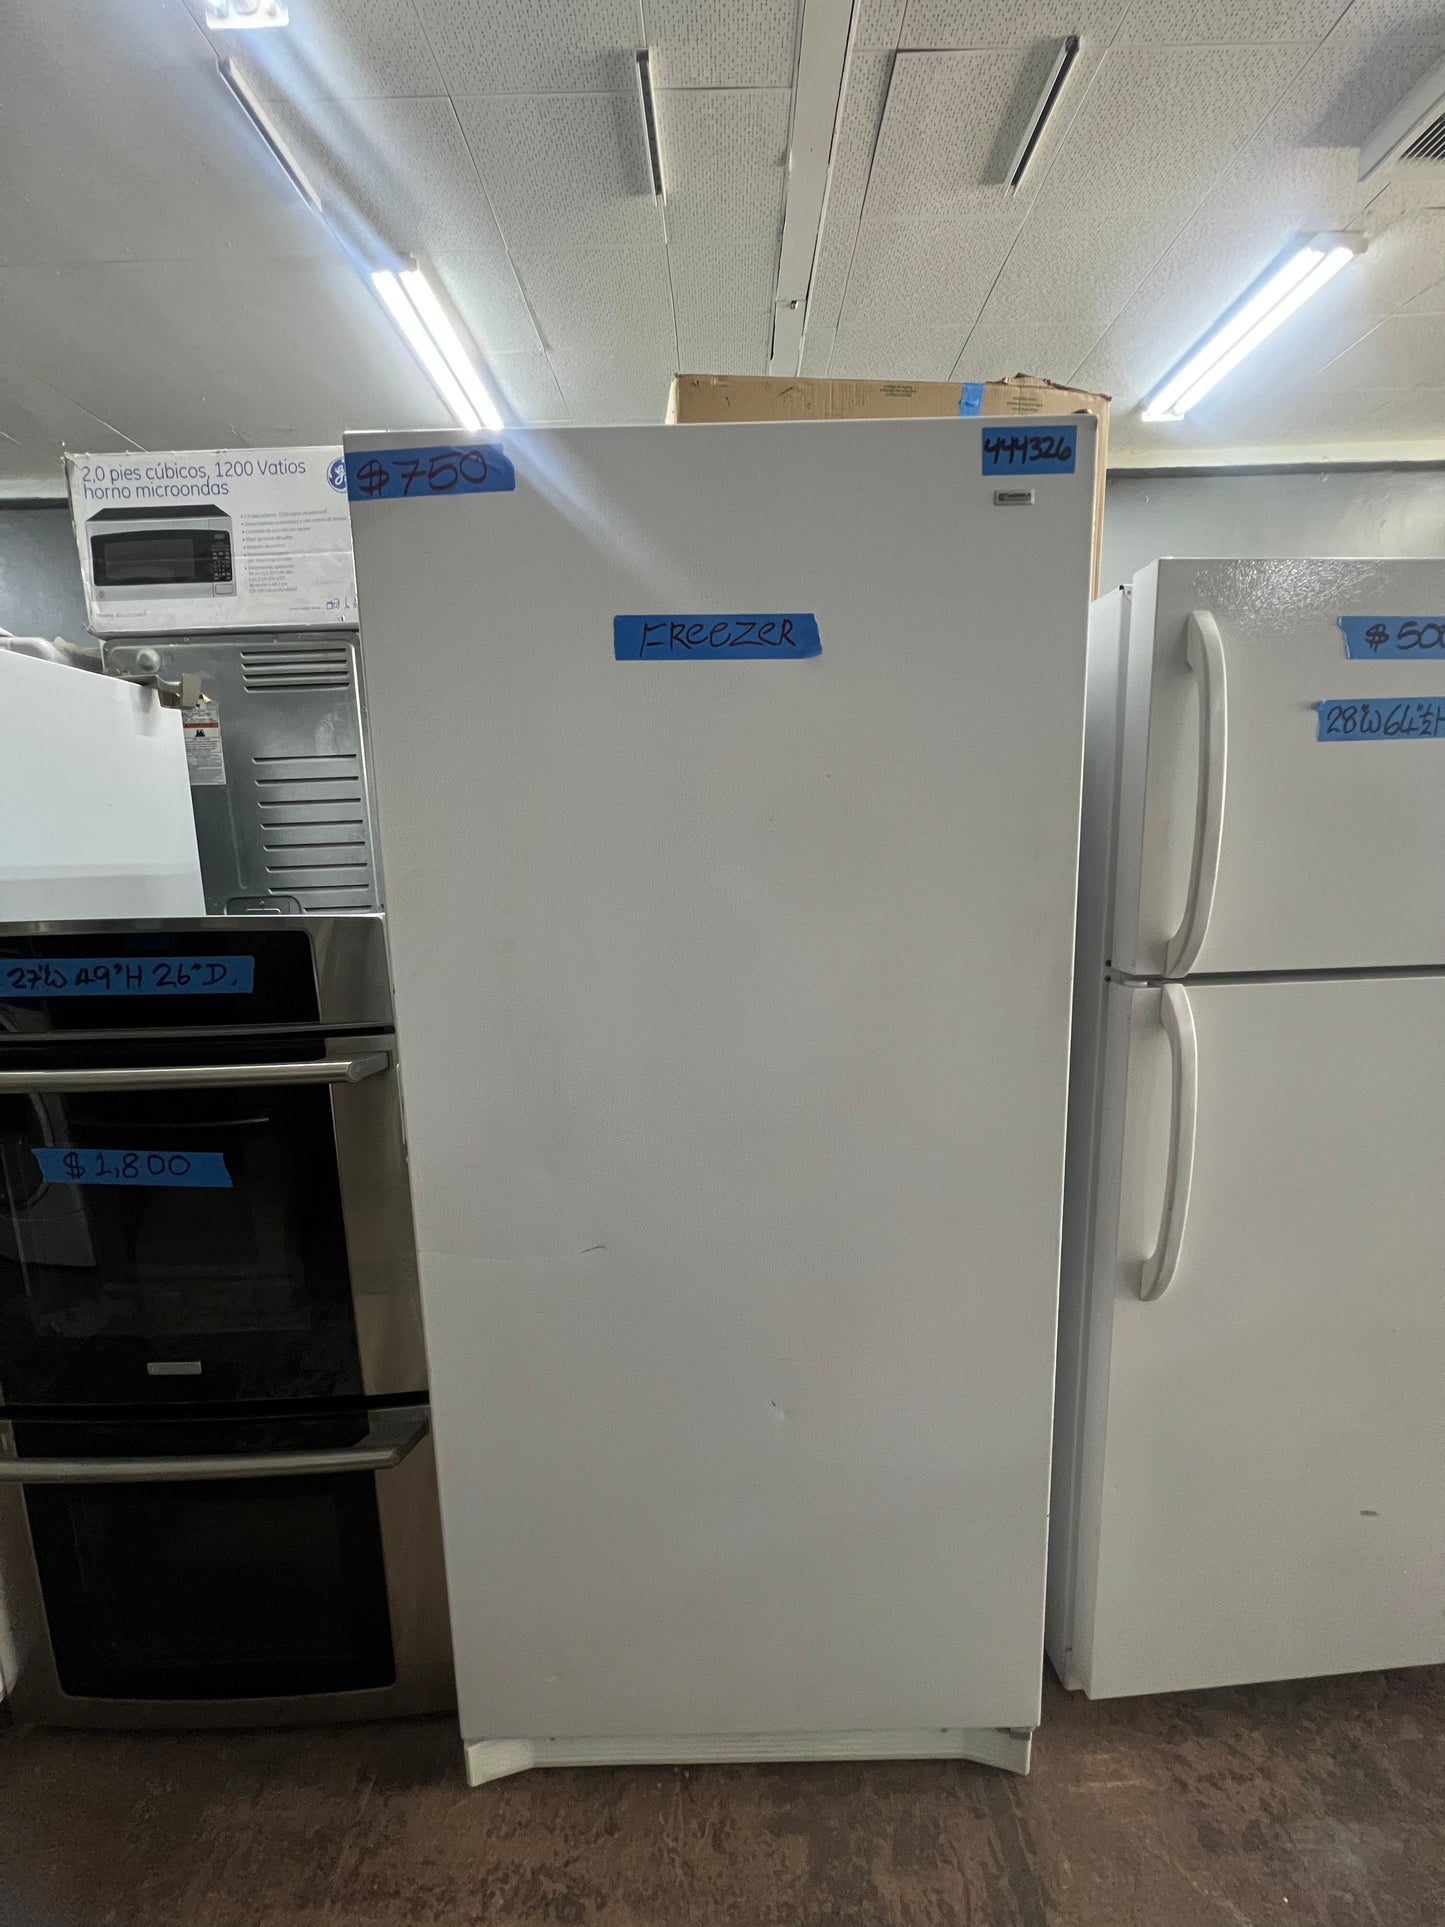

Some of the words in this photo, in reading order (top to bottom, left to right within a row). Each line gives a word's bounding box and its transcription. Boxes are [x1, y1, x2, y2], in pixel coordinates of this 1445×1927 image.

[984, 435, 1072, 464] 444326
[82, 465, 105, 483] 2,0
[110, 464, 141, 485] pies
[145, 463, 210, 482] cúbicos,
[214, 461, 254, 478] 1200
[257, 459, 306, 476] Vatios
[356, 451, 487, 496] $750
[83, 483, 131, 500] horno
[136, 480, 229, 498] microondas
[1364, 621, 1445, 652] $50
